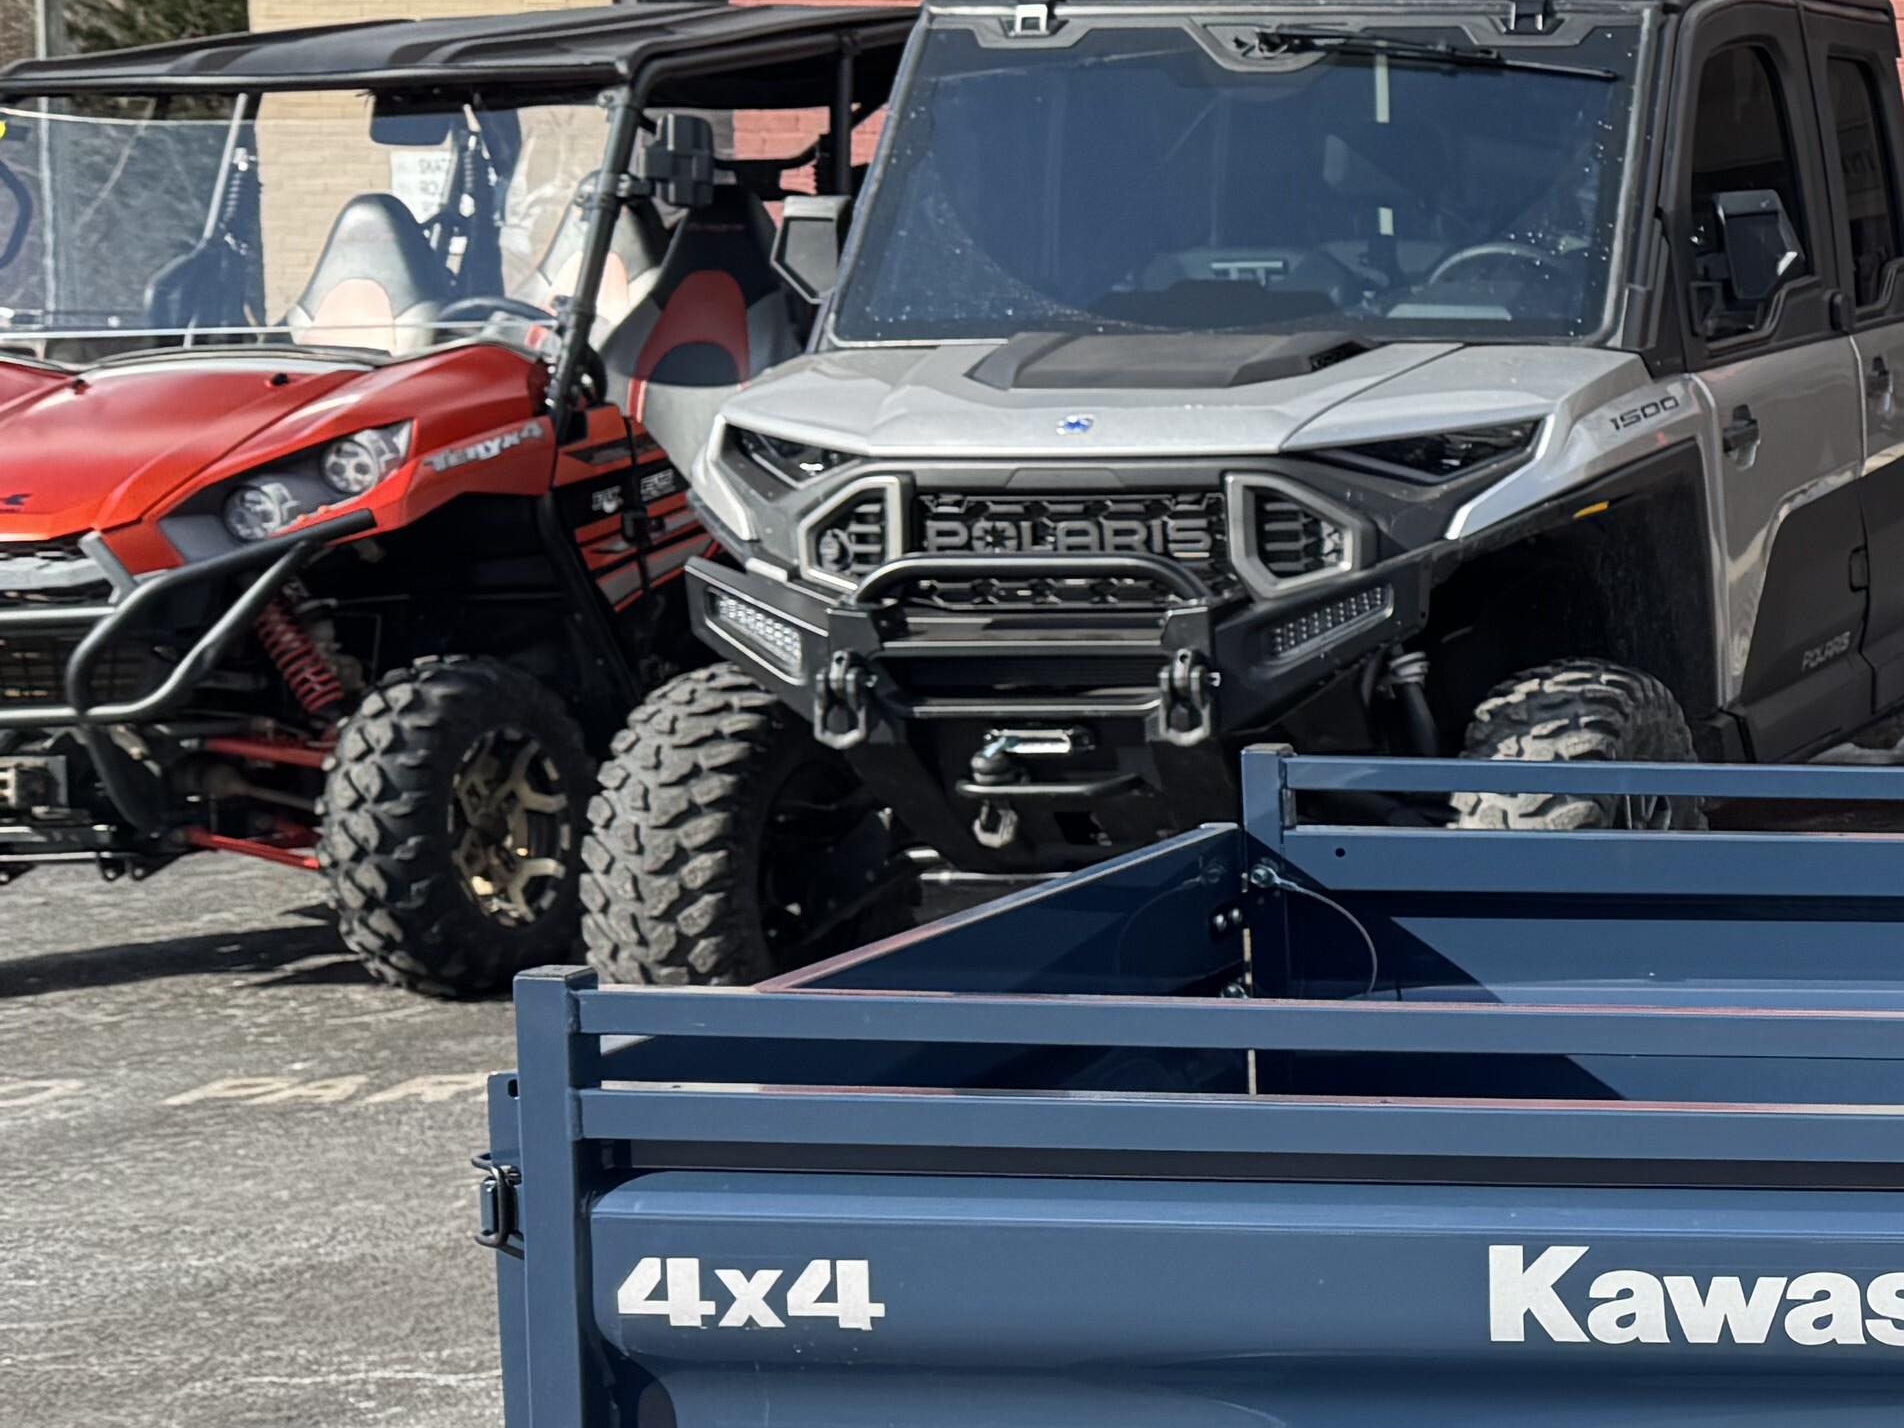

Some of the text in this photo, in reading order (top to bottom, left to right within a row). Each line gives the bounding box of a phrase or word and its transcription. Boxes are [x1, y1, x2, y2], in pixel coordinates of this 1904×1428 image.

[1610, 396, 1679, 431] 1500
[925, 518, 1212, 558] POLARIS
[617, 1257, 885, 1329] 4x4
